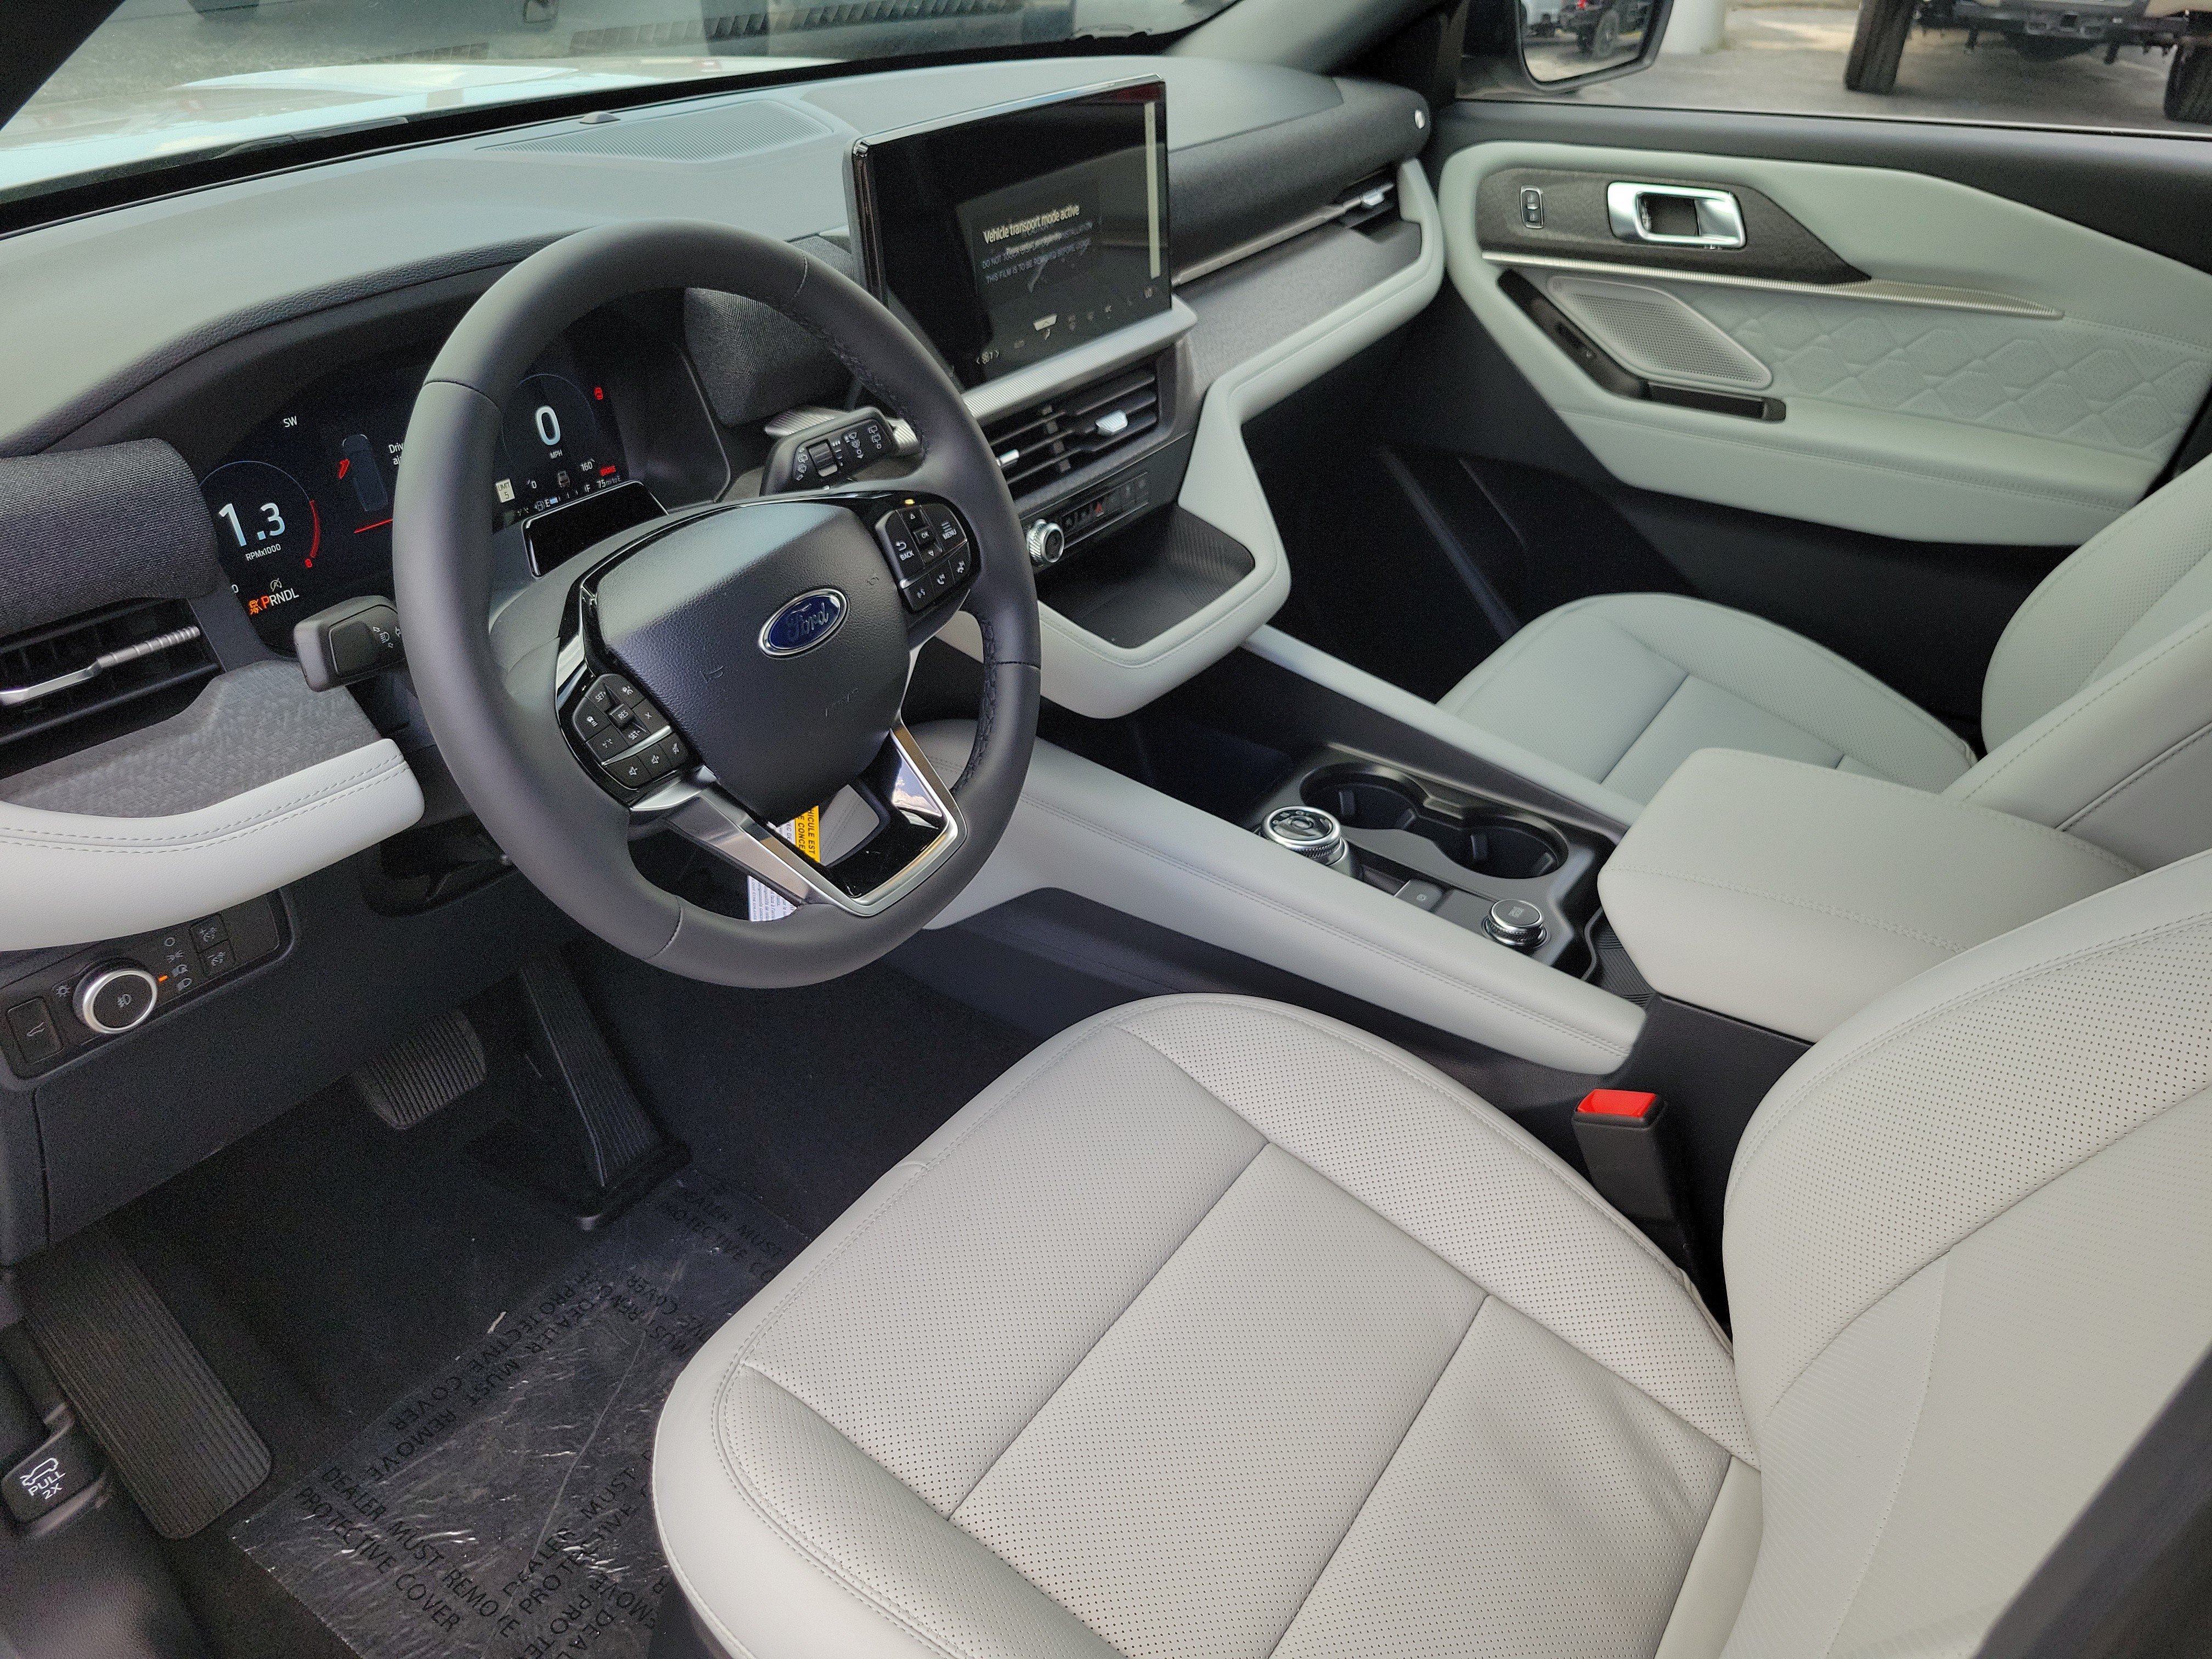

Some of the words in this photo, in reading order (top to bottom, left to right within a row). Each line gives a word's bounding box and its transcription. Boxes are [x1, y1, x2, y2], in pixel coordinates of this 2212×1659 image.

[983, 225, 1009, 244] Vehicle
[1010, 215, 1041, 236] transport
[1042, 209, 1061, 227] mode
[1061, 204, 1081, 219] active
[283, 416, 297, 428] SW
[534, 406, 561, 445] 0
[550, 449, 563, 460] MPH
[497, 482, 510, 492] LIMIT
[504, 492, 510, 500] 5
[596, 479, 606, 489] 75
[219, 503, 285, 546] 1.3
[921, 531, 930, 539] OK
[942, 528, 957, 540] MENU
[245, 543, 281, 561] RPMx1000
[304, 558, 313, 568] 8
[899, 550, 915, 561] BACK
[786, 602, 829, 642] Ford
[618, 710, 629, 720] RES
[466, 1284, 576, 1372] PROTECTIVE
[525, 1297, 594, 1354] DEALER
[466, 1358, 521, 1406] MUST
[389, 1375, 462, 1431] COVER
[365, 1408, 458, 1482] REMOVE
[28, 1471, 66, 1496] PULL
[43, 1482, 63, 1499] 2X
[580, 1467, 638, 1520] MUST
[321, 1465, 387, 1522] DEALER
[387, 1521, 445, 1567] MUST
[294, 1486, 397, 1575] PROTECTIVE
[394, 1572, 461, 1633] COVER
